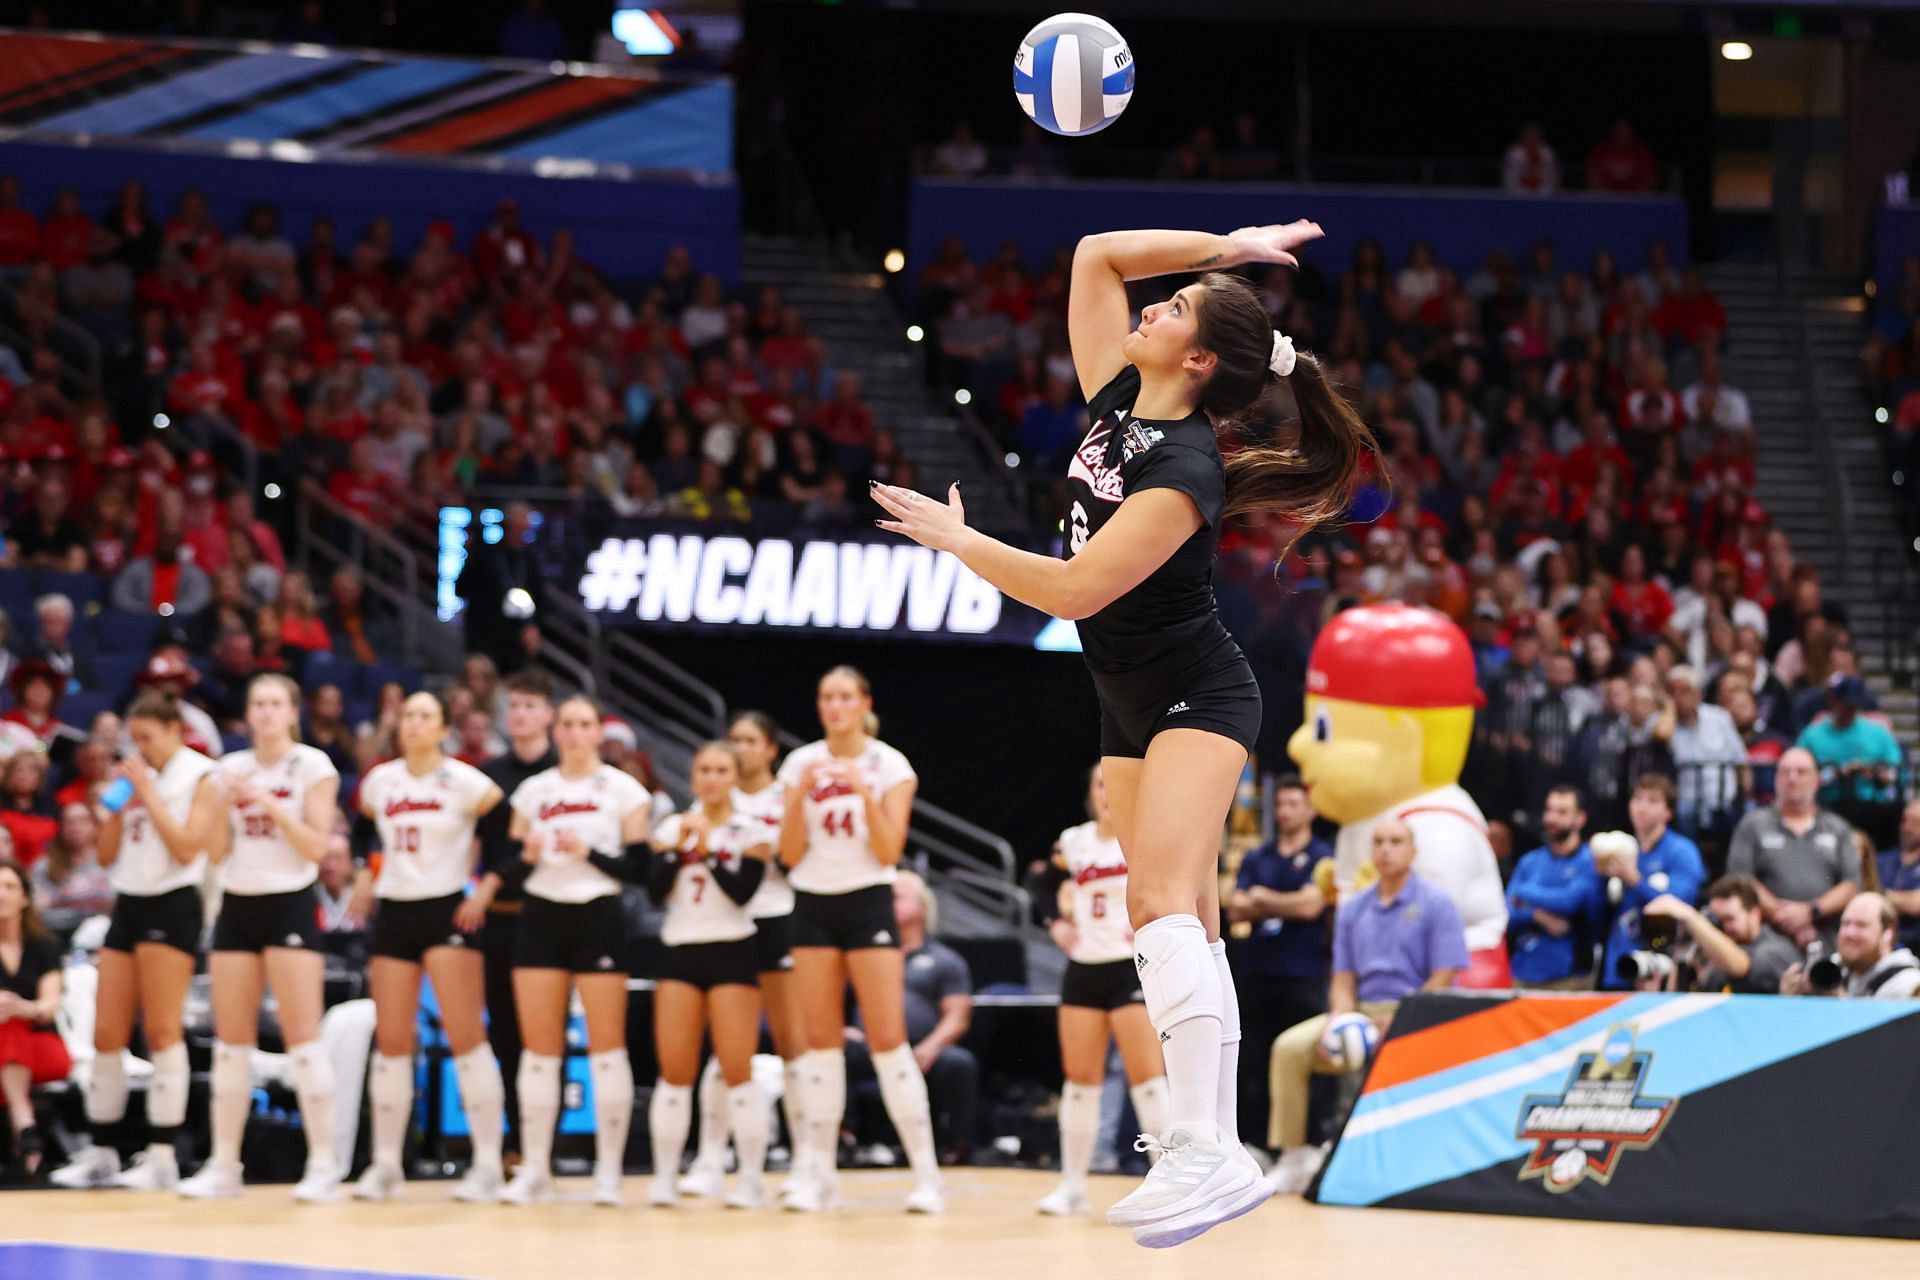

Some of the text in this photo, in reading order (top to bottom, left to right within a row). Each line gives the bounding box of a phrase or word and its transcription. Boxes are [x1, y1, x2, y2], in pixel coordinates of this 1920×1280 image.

[579, 534, 1001, 633] #NCAAWVB
[823, 811, 853, 837] 44
[692, 876, 705, 903] 7
